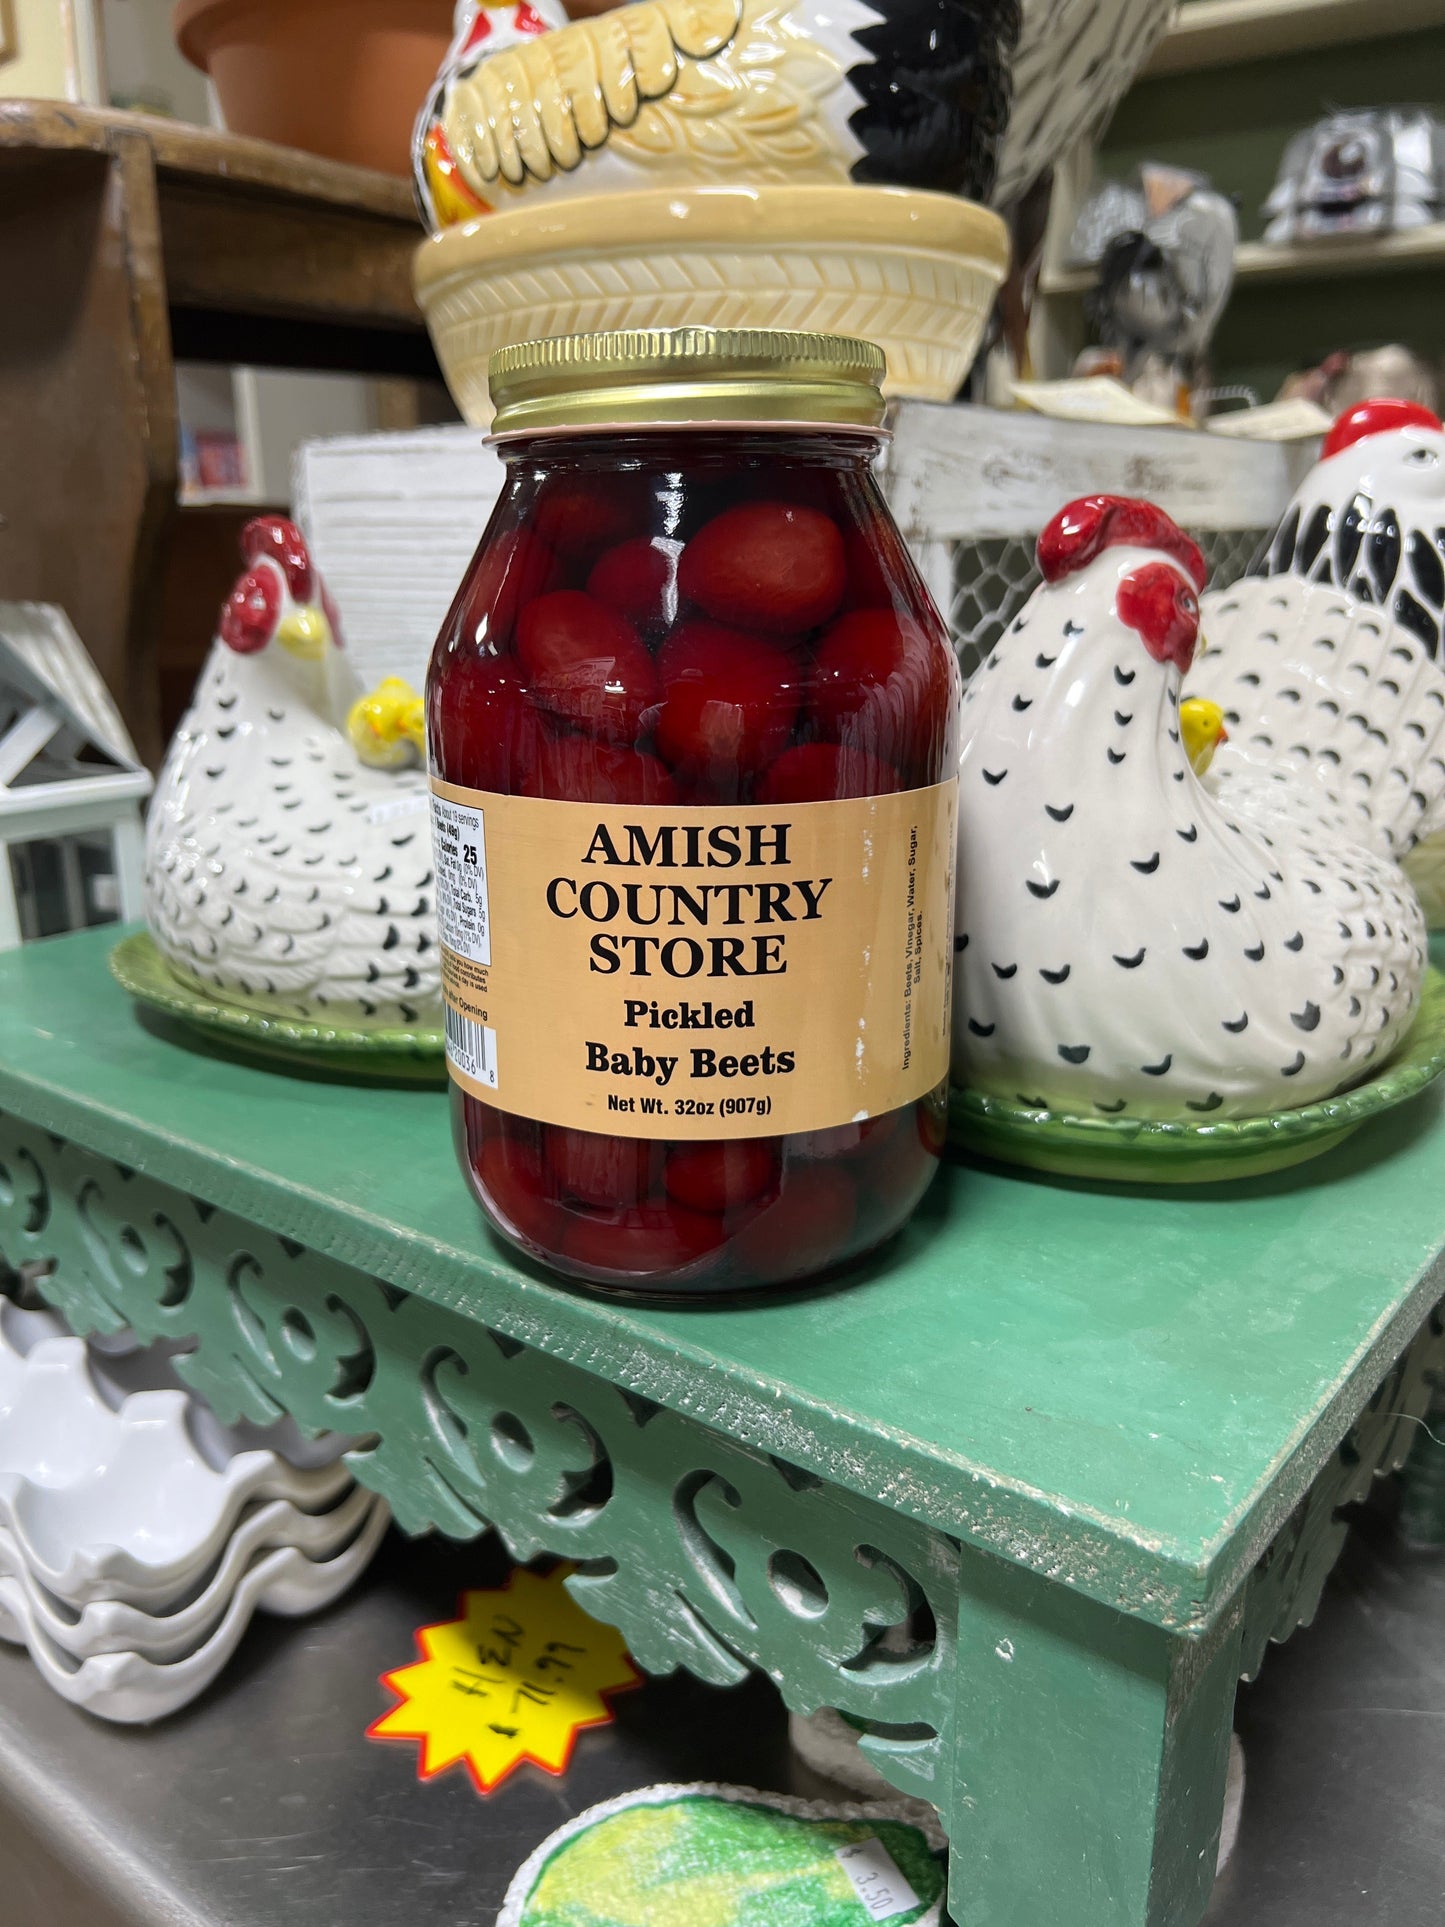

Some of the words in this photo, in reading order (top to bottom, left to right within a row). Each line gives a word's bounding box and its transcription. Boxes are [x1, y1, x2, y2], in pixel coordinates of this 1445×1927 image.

[458, 813, 480, 831] servings
[463, 843, 478, 866] 25
[581, 824, 793, 868] AMISH
[908, 825, 918, 866] Sugar,
[475, 893, 483, 907] 5g
[547, 878, 833, 926] COUNTRY
[906, 868, 916, 908] Water,
[459, 915, 475, 931] Protein
[461, 902, 476, 917] Sugars
[478, 907, 486, 922] 5g
[905, 907, 915, 959] Vinegar,
[914, 910, 923, 956] Spices.
[464, 961, 473, 972] how
[473, 966, 489, 977] much
[590, 934, 788, 979] STORE
[913, 956, 922, 984] Salt,
[474, 982, 488, 993] used
[904, 959, 913, 997] Beets,
[459, 997, 488, 1021] Opening
[624, 1000, 756, 1030] Pickled
[902, 999, 912, 1070] Ingredients:
[489, 1070, 495, 1083] 8
[586, 1041, 679, 1087] Baby
[690, 1046, 796, 1078] Beets
[608, 1095, 636, 1113] Net
[639, 1097, 669, 1115] Wt.
[674, 1098, 715, 1116] 32oz
[719, 1095, 772, 1117] (907g)
[451, 1613, 525, 1698] HEN
